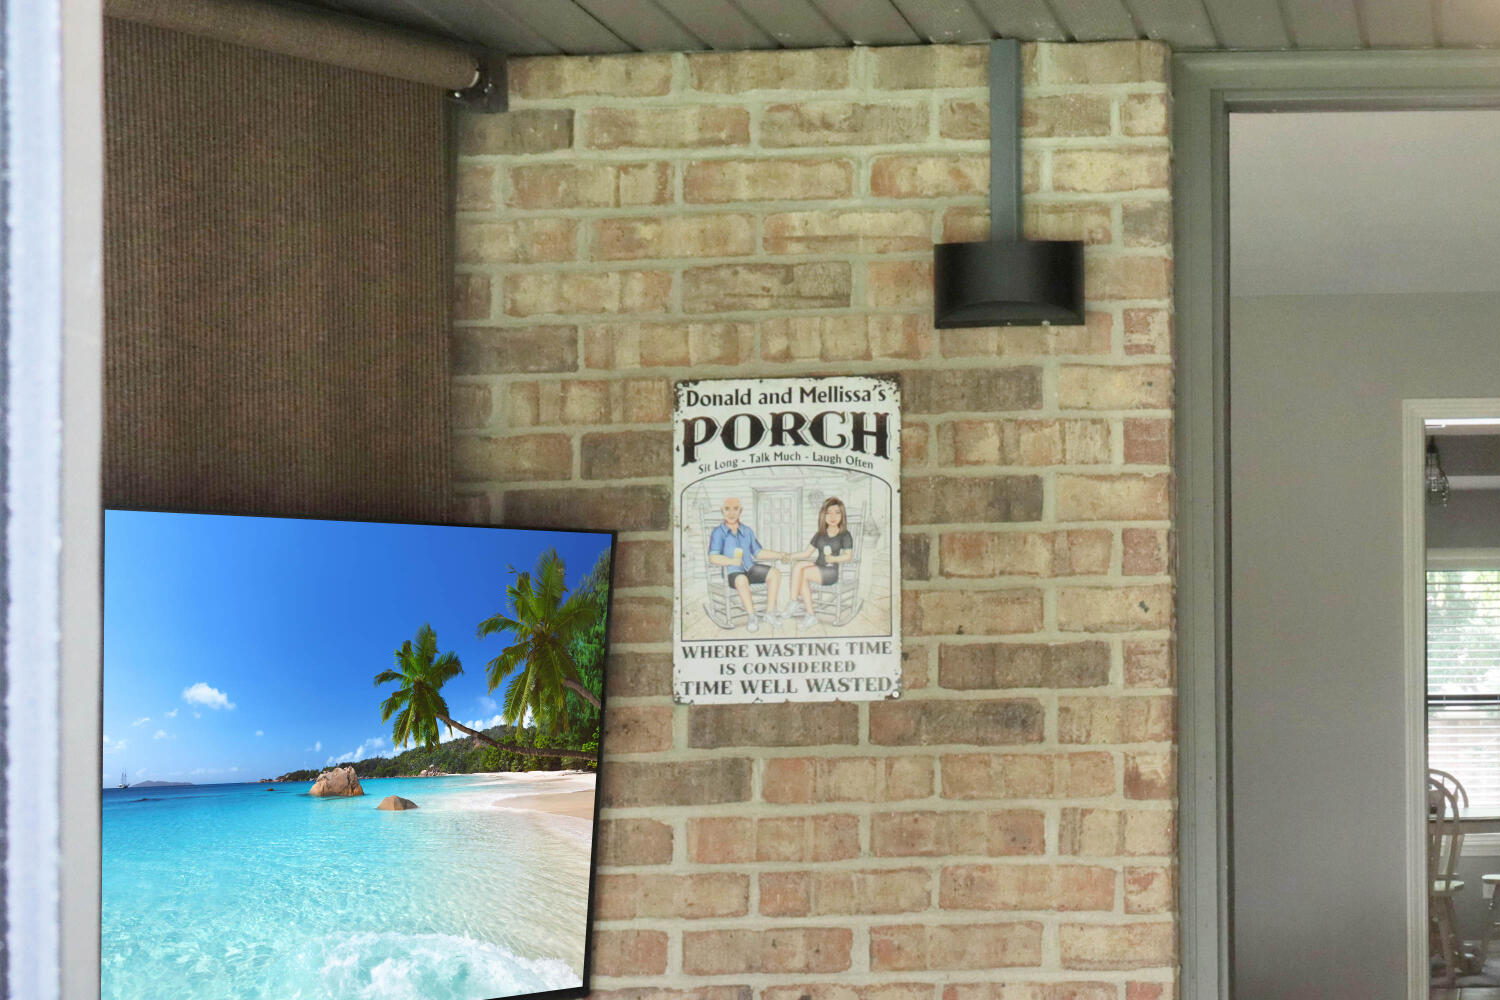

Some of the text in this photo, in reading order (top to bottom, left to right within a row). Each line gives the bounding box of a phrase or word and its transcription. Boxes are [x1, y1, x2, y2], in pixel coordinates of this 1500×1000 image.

[686, 384, 887, 407] Donald and Mellissa's
[681, 410, 891, 467] PORCH
[699, 461, 711, 474] Sit
[714, 457, 738, 471] Long
[750, 453, 770, 464] Talk
[774, 451, 801, 461] Much
[812, 451, 842, 465] Laugh
[846, 455, 874, 470] Often
[681, 641, 893, 659] WHERE WASTING TIME
[719, 660, 856, 676] IS CONSIDERED
[680, 676, 892, 696] TIME WELL WASTED
